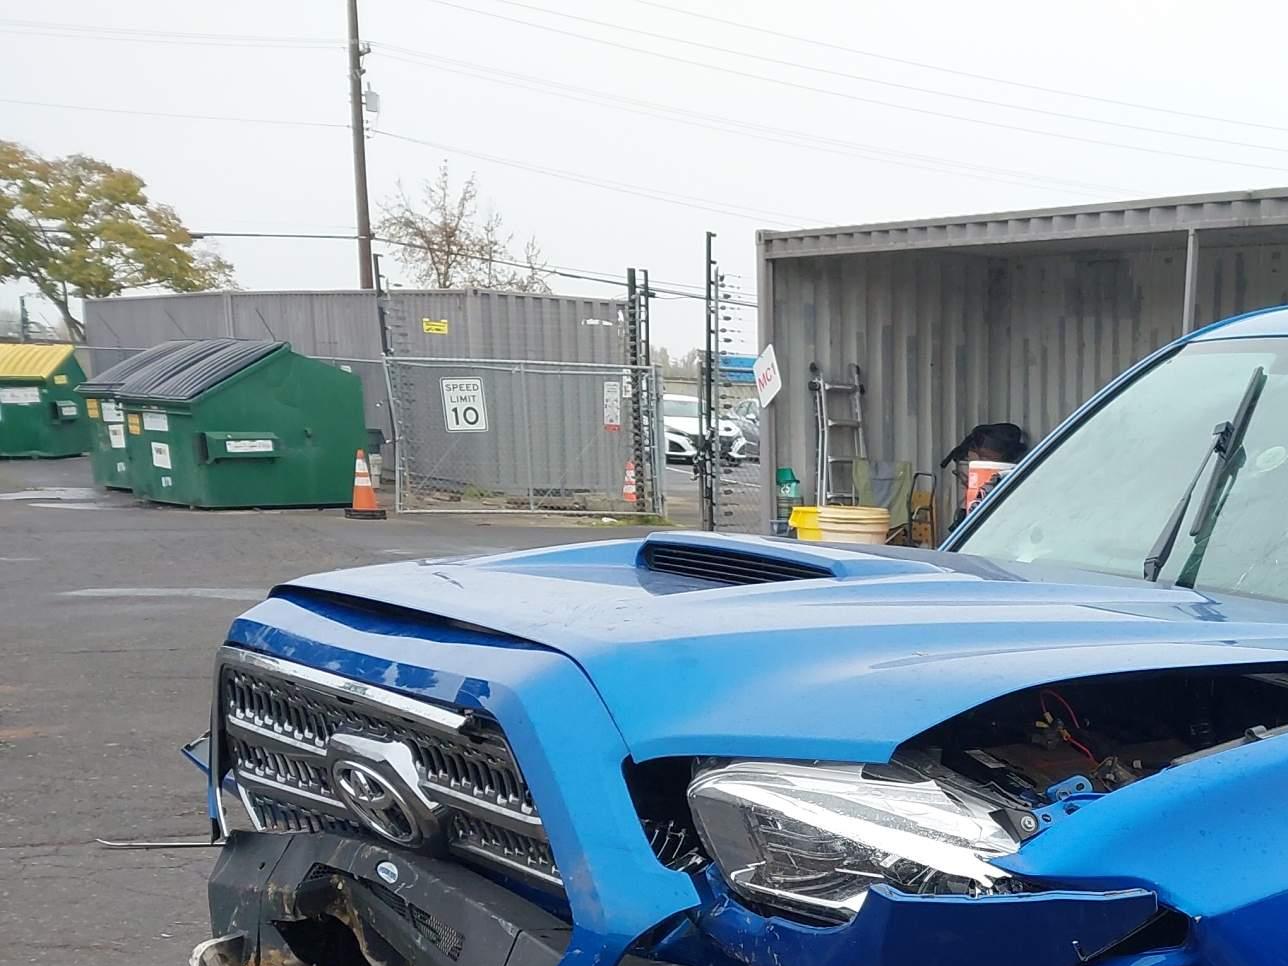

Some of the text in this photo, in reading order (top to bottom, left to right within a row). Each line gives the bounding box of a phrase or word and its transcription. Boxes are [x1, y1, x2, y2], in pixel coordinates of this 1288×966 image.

[757, 361, 777, 393] MC1
[444, 383, 479, 392] SPEED
[450, 395, 477, 403] LIMIT
[451, 406, 479, 426] 10
